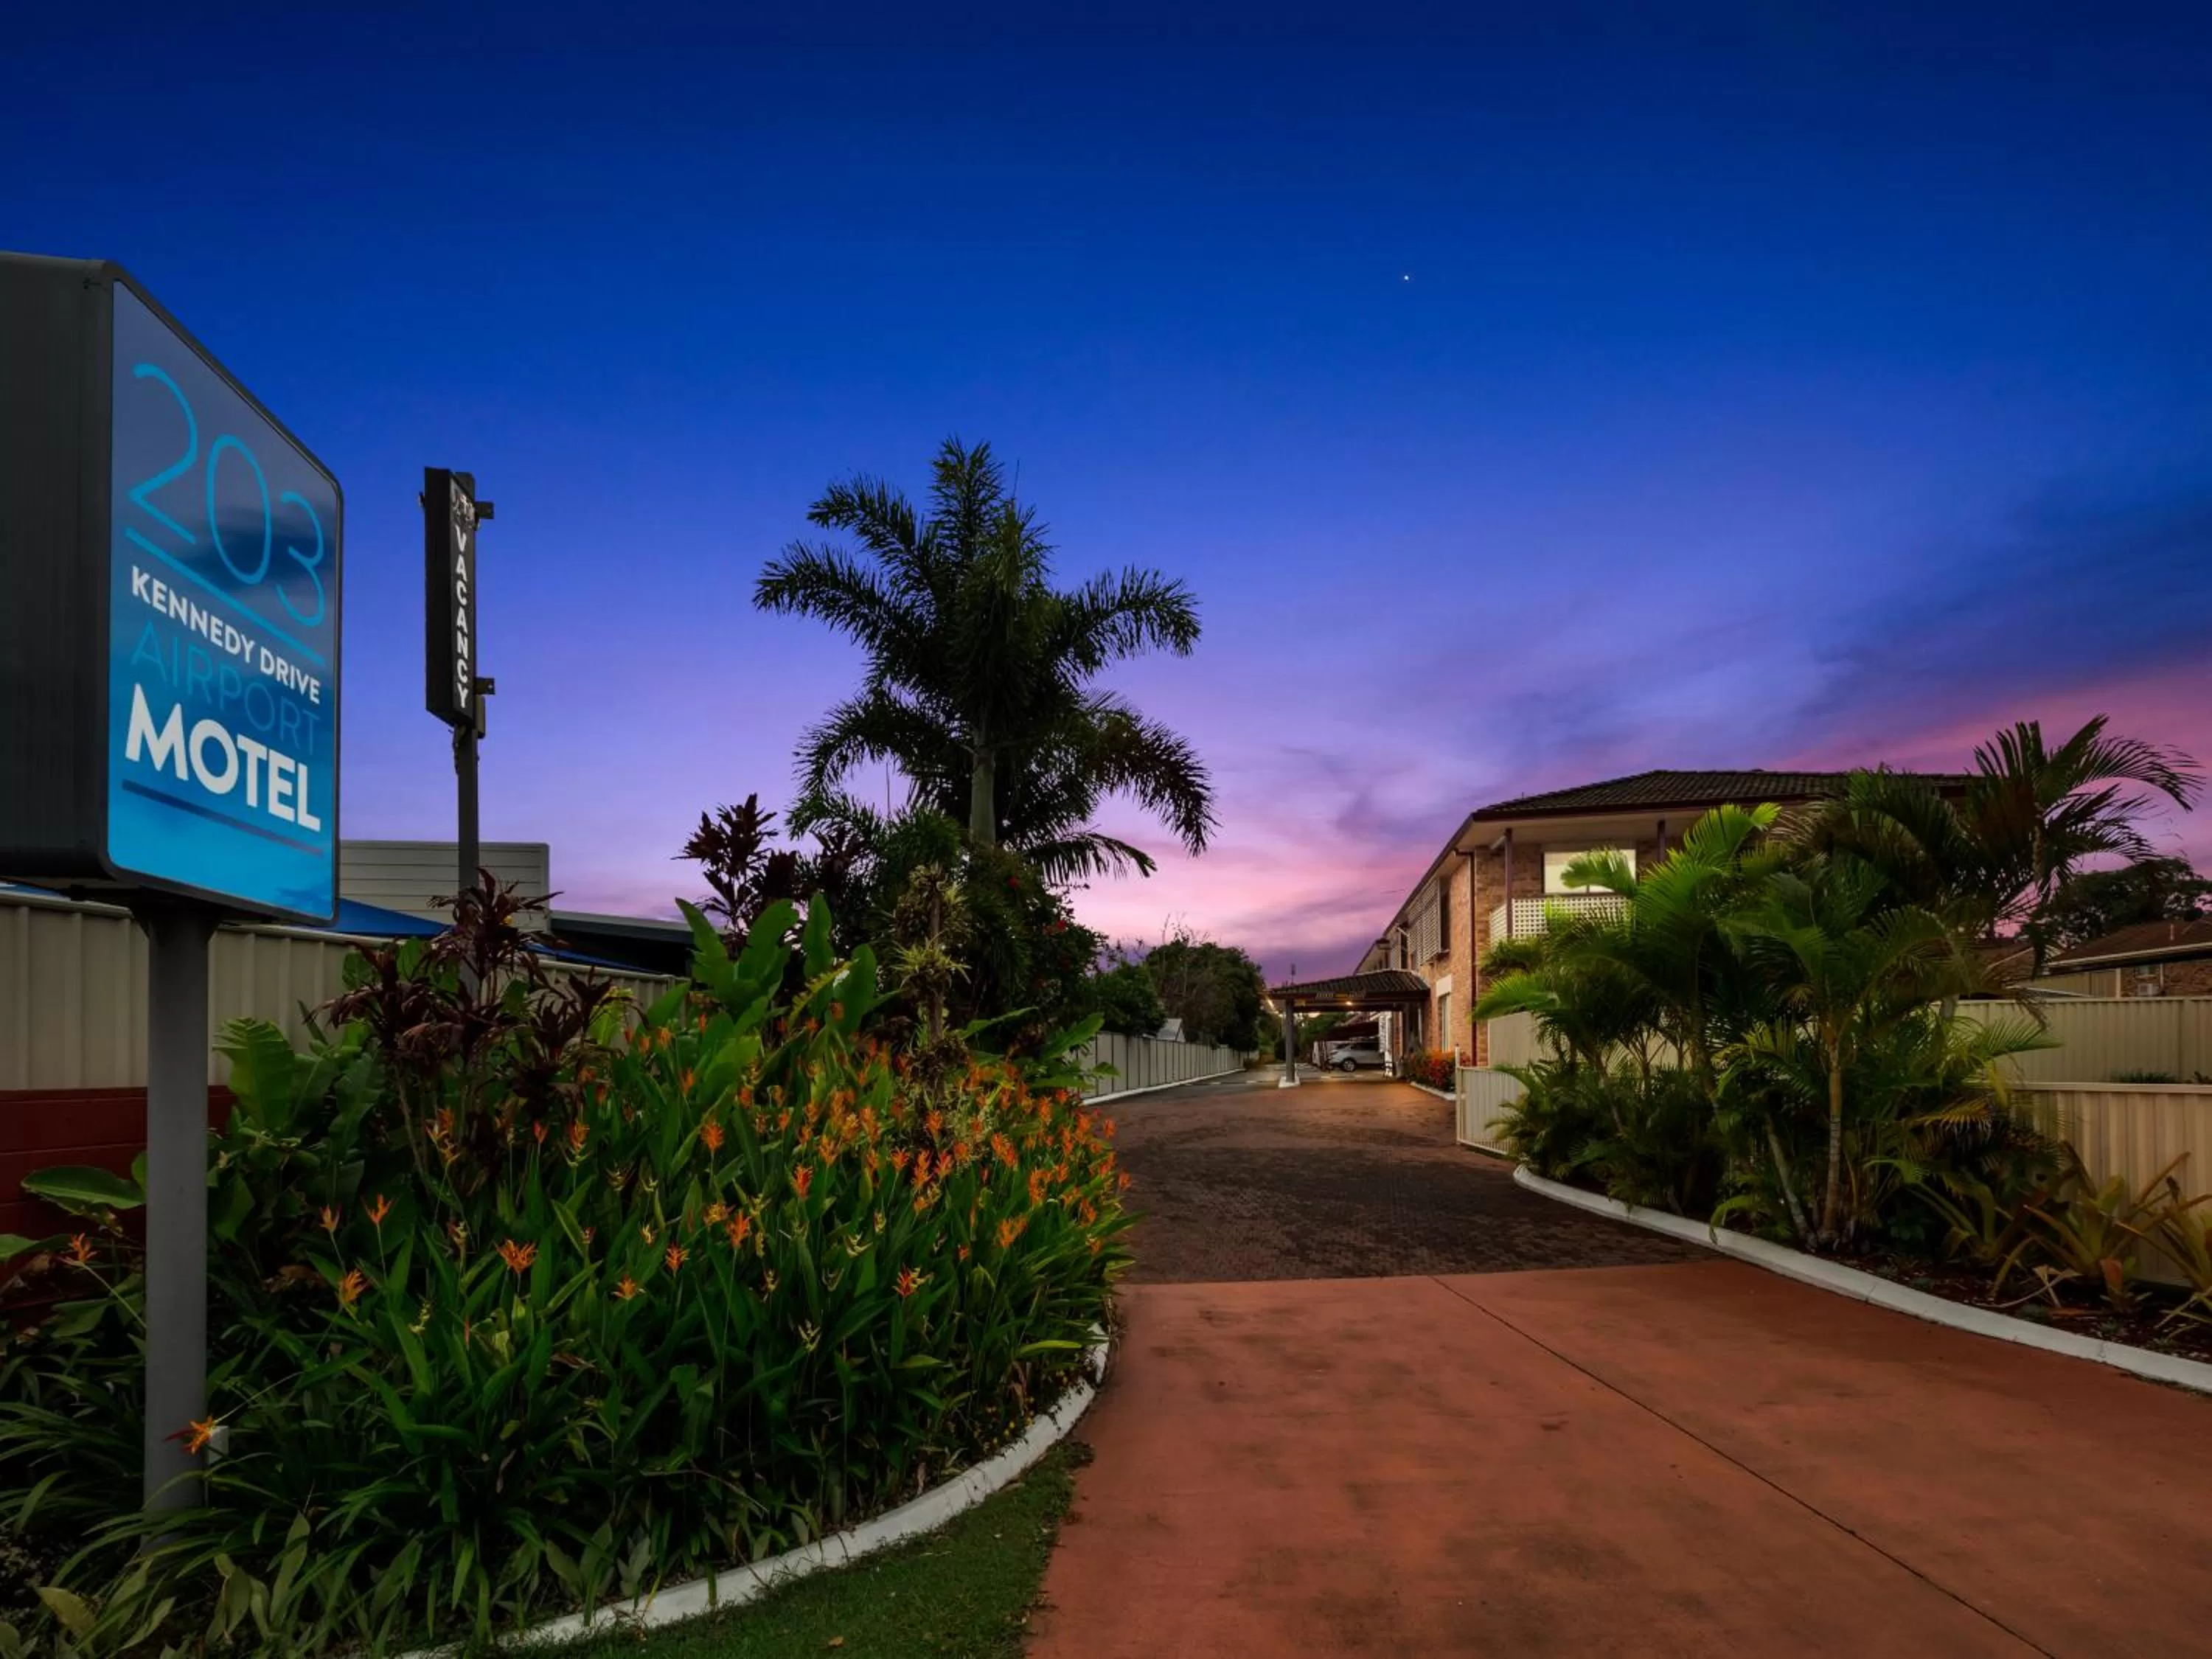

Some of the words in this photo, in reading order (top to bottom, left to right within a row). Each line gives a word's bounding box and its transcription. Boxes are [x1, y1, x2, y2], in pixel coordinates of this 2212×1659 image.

[128, 363, 324, 627] 203
[131, 565, 256, 664] KENNEDY
[260, 646, 321, 704] DRIVE
[131, 621, 321, 756] AIRPORT
[455, 524, 469, 709] VACANCY
[125, 683, 321, 832] MOTEL
